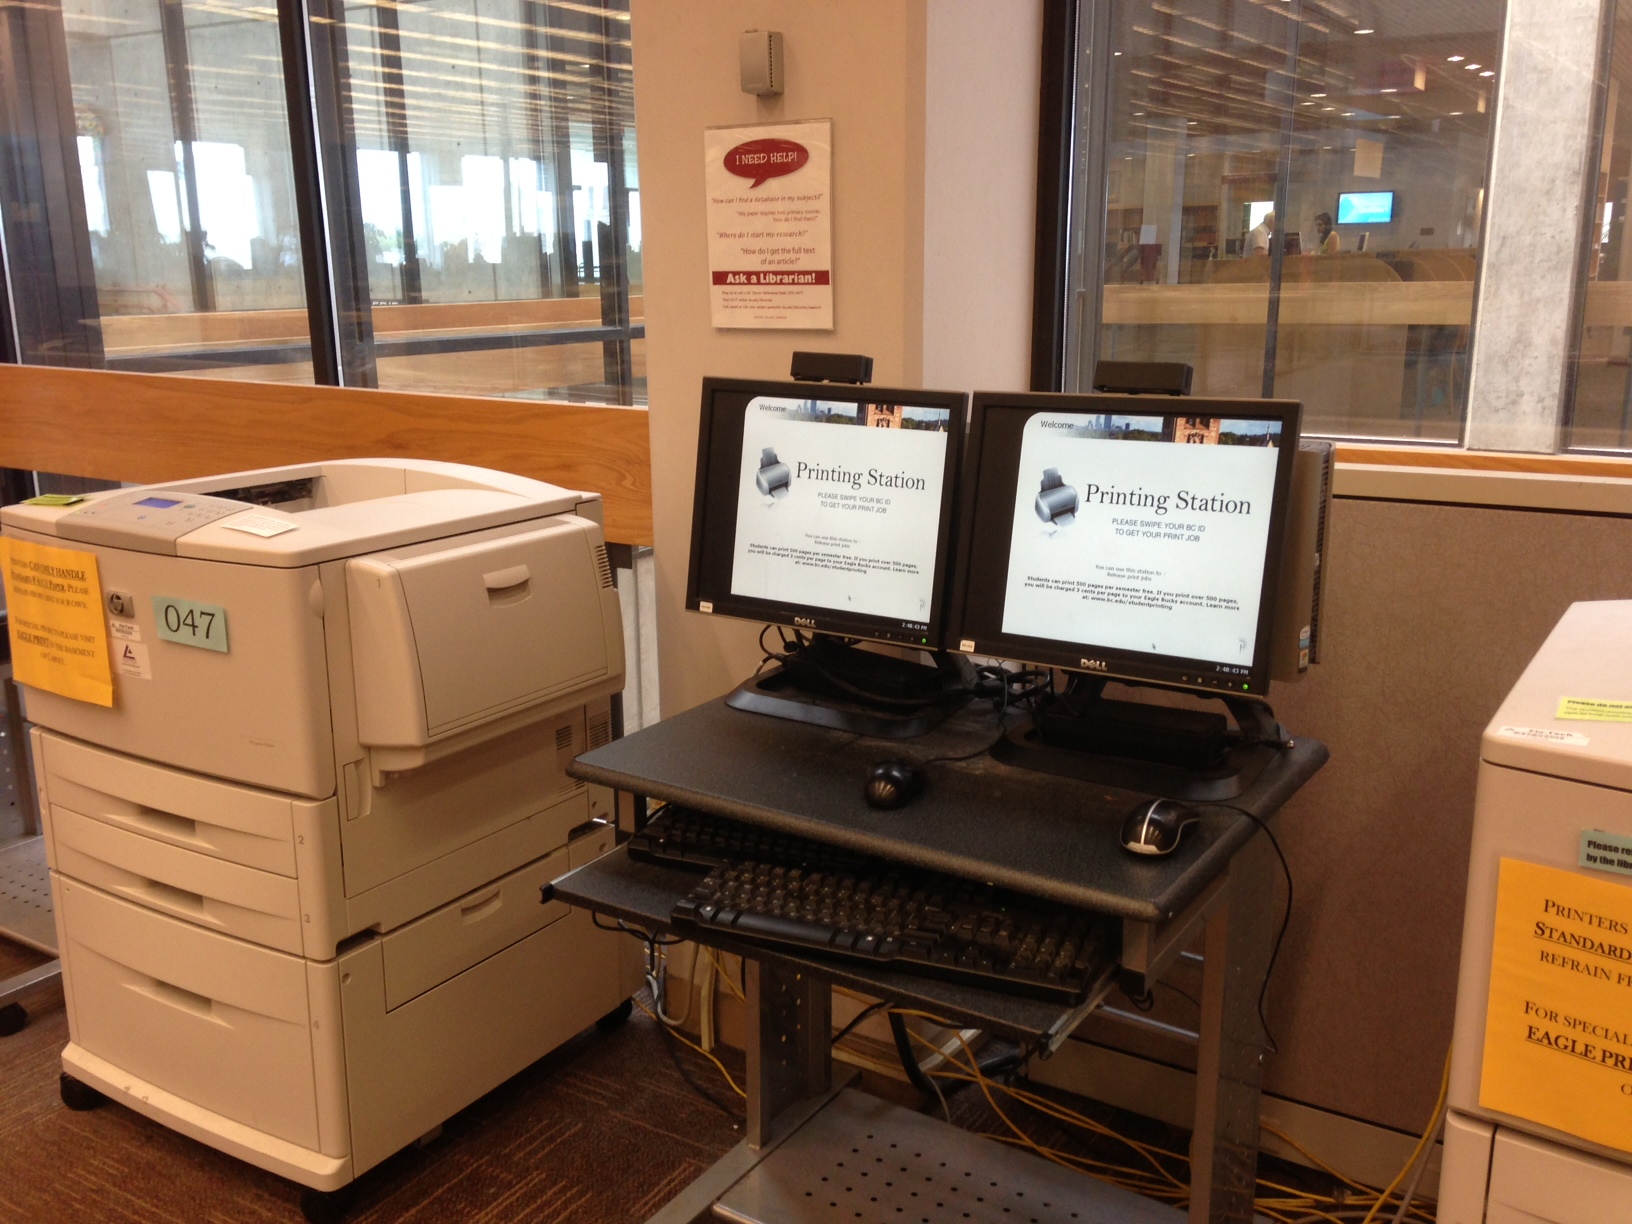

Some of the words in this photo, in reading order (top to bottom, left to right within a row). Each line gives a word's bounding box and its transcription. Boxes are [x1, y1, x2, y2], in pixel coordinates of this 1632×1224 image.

[736, 155, 740, 164] I
[742, 154, 767, 164] NEED
[770, 152, 797, 163] HELP!
[770, 248, 780, 256] get
[726, 273, 747, 284] Ask
[750, 275, 757, 284] a
[760, 272, 816, 284] Librarian!
[758, 404, 786, 413] Welcome
[1040, 420, 1074, 430] Welcome
[796, 462, 863, 490] Printing
[867, 468, 926, 490] Station
[818, 492, 838, 500] PLEASE
[840, 494, 858, 502] SWIPE
[858, 496, 875, 504] YOUR
[1084, 484, 1170, 516] Printing
[1176, 490, 1252, 515] Station
[841, 503, 857, 511] YOUR
[876, 506, 887, 514] JOB
[1112, 518, 1138, 528] PLEASE
[1140, 520, 1162, 529] SWIPE
[1164, 522, 1185, 530] YOUR
[1186, 523, 1196, 532] BC
[1198, 524, 1206, 532] ID
[1115, 528, 1126, 536] TO
[1126, 528, 1140, 538] GET
[1141, 530, 1162, 539] YOUR
[1163, 532, 1184, 541] PRINT
[1185, 533, 1200, 542] JOB
[1091, 596, 1172, 610] www.bc.edu/studentprinting
[165, 604, 216, 640] 047
[794, 617, 816, 628] DELL
[1080, 658, 1108, 671] DELL
[1215, 665, 1240, 675] 2:48:43
[298, 834, 304, 845] 2
[1587, 840, 1619, 853] Please
[1586, 853, 1598, 863] by
[1599, 856, 1615, 866] the
[304, 914, 311, 924] 3
[1544, 898, 1628, 935] PRINTERS
[1540, 950, 1612, 982] REFRAIN
[1524, 1000, 1559, 1024] FOR
[1526, 1025, 1596, 1061] EAGLE
